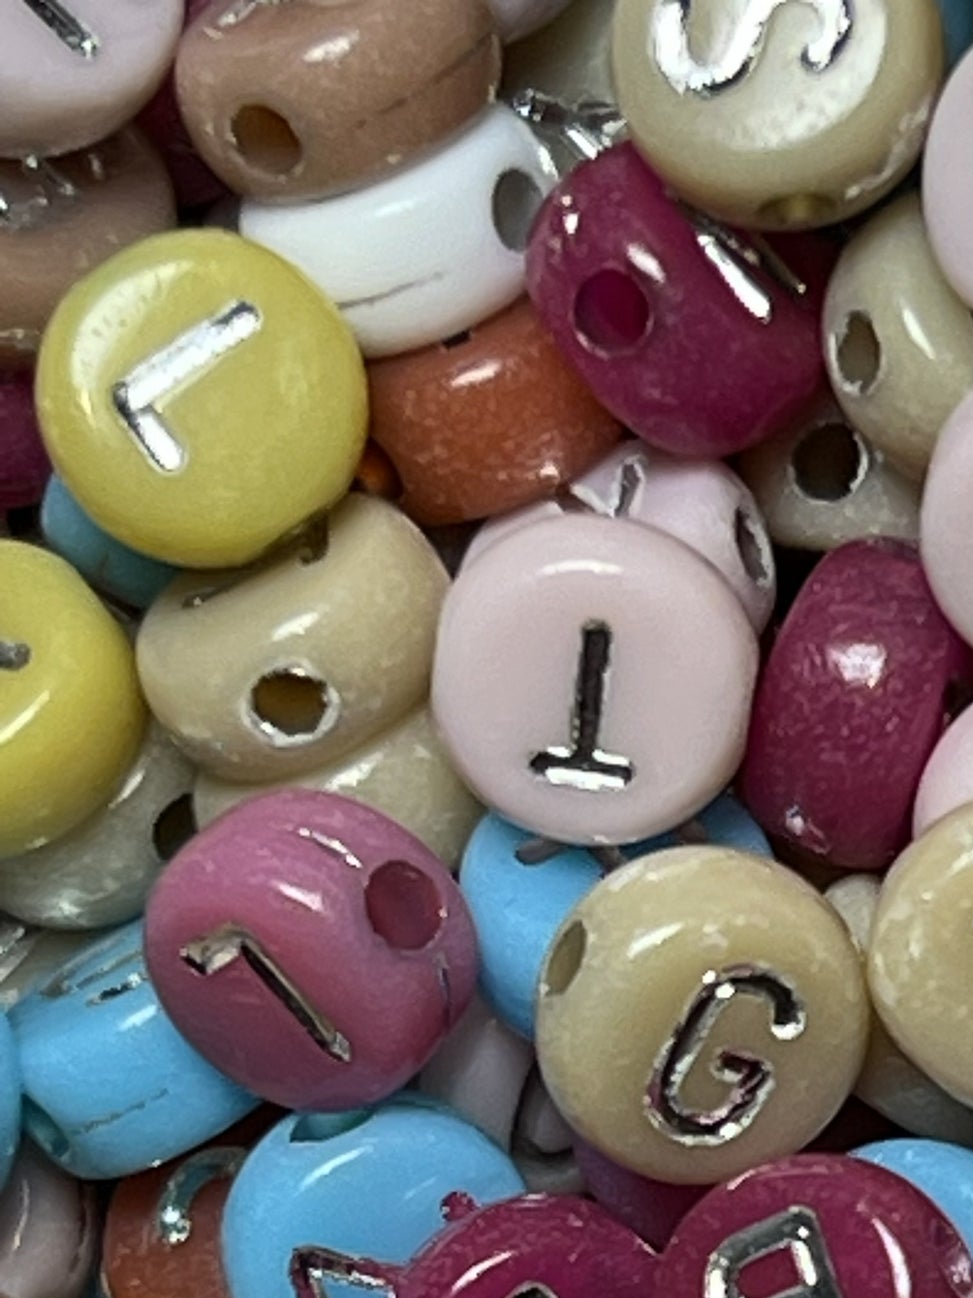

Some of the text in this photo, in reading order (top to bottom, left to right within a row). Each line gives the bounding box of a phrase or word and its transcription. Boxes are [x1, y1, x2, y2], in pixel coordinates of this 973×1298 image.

[653, 0, 853, 95] S
[112, 298, 262, 474] L
[643, 963, 806, 1147] G
